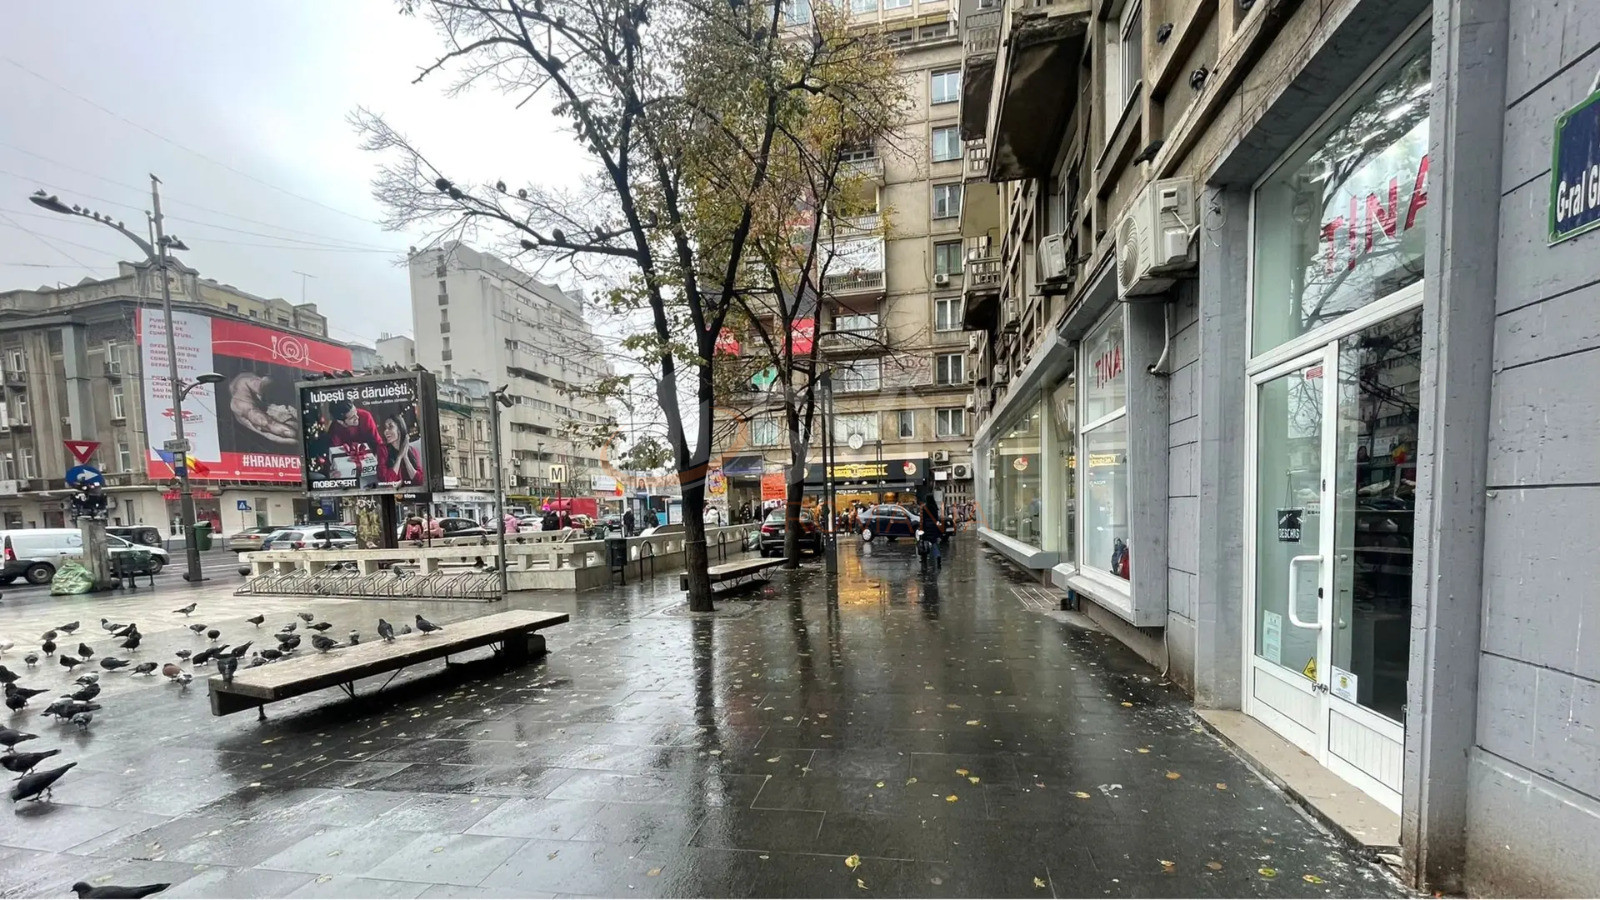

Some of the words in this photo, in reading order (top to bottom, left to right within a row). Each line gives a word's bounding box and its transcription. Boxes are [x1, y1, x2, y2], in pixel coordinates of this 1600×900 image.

[1556, 170, 1587, 223] G-ral
[1588, 164, 1600, 209] G
[310, 388, 345, 404] Iubești
[347, 387, 360, 401] să
[551, 467, 561, 478] M
[313, 479, 357, 489] MOBEXPERT
